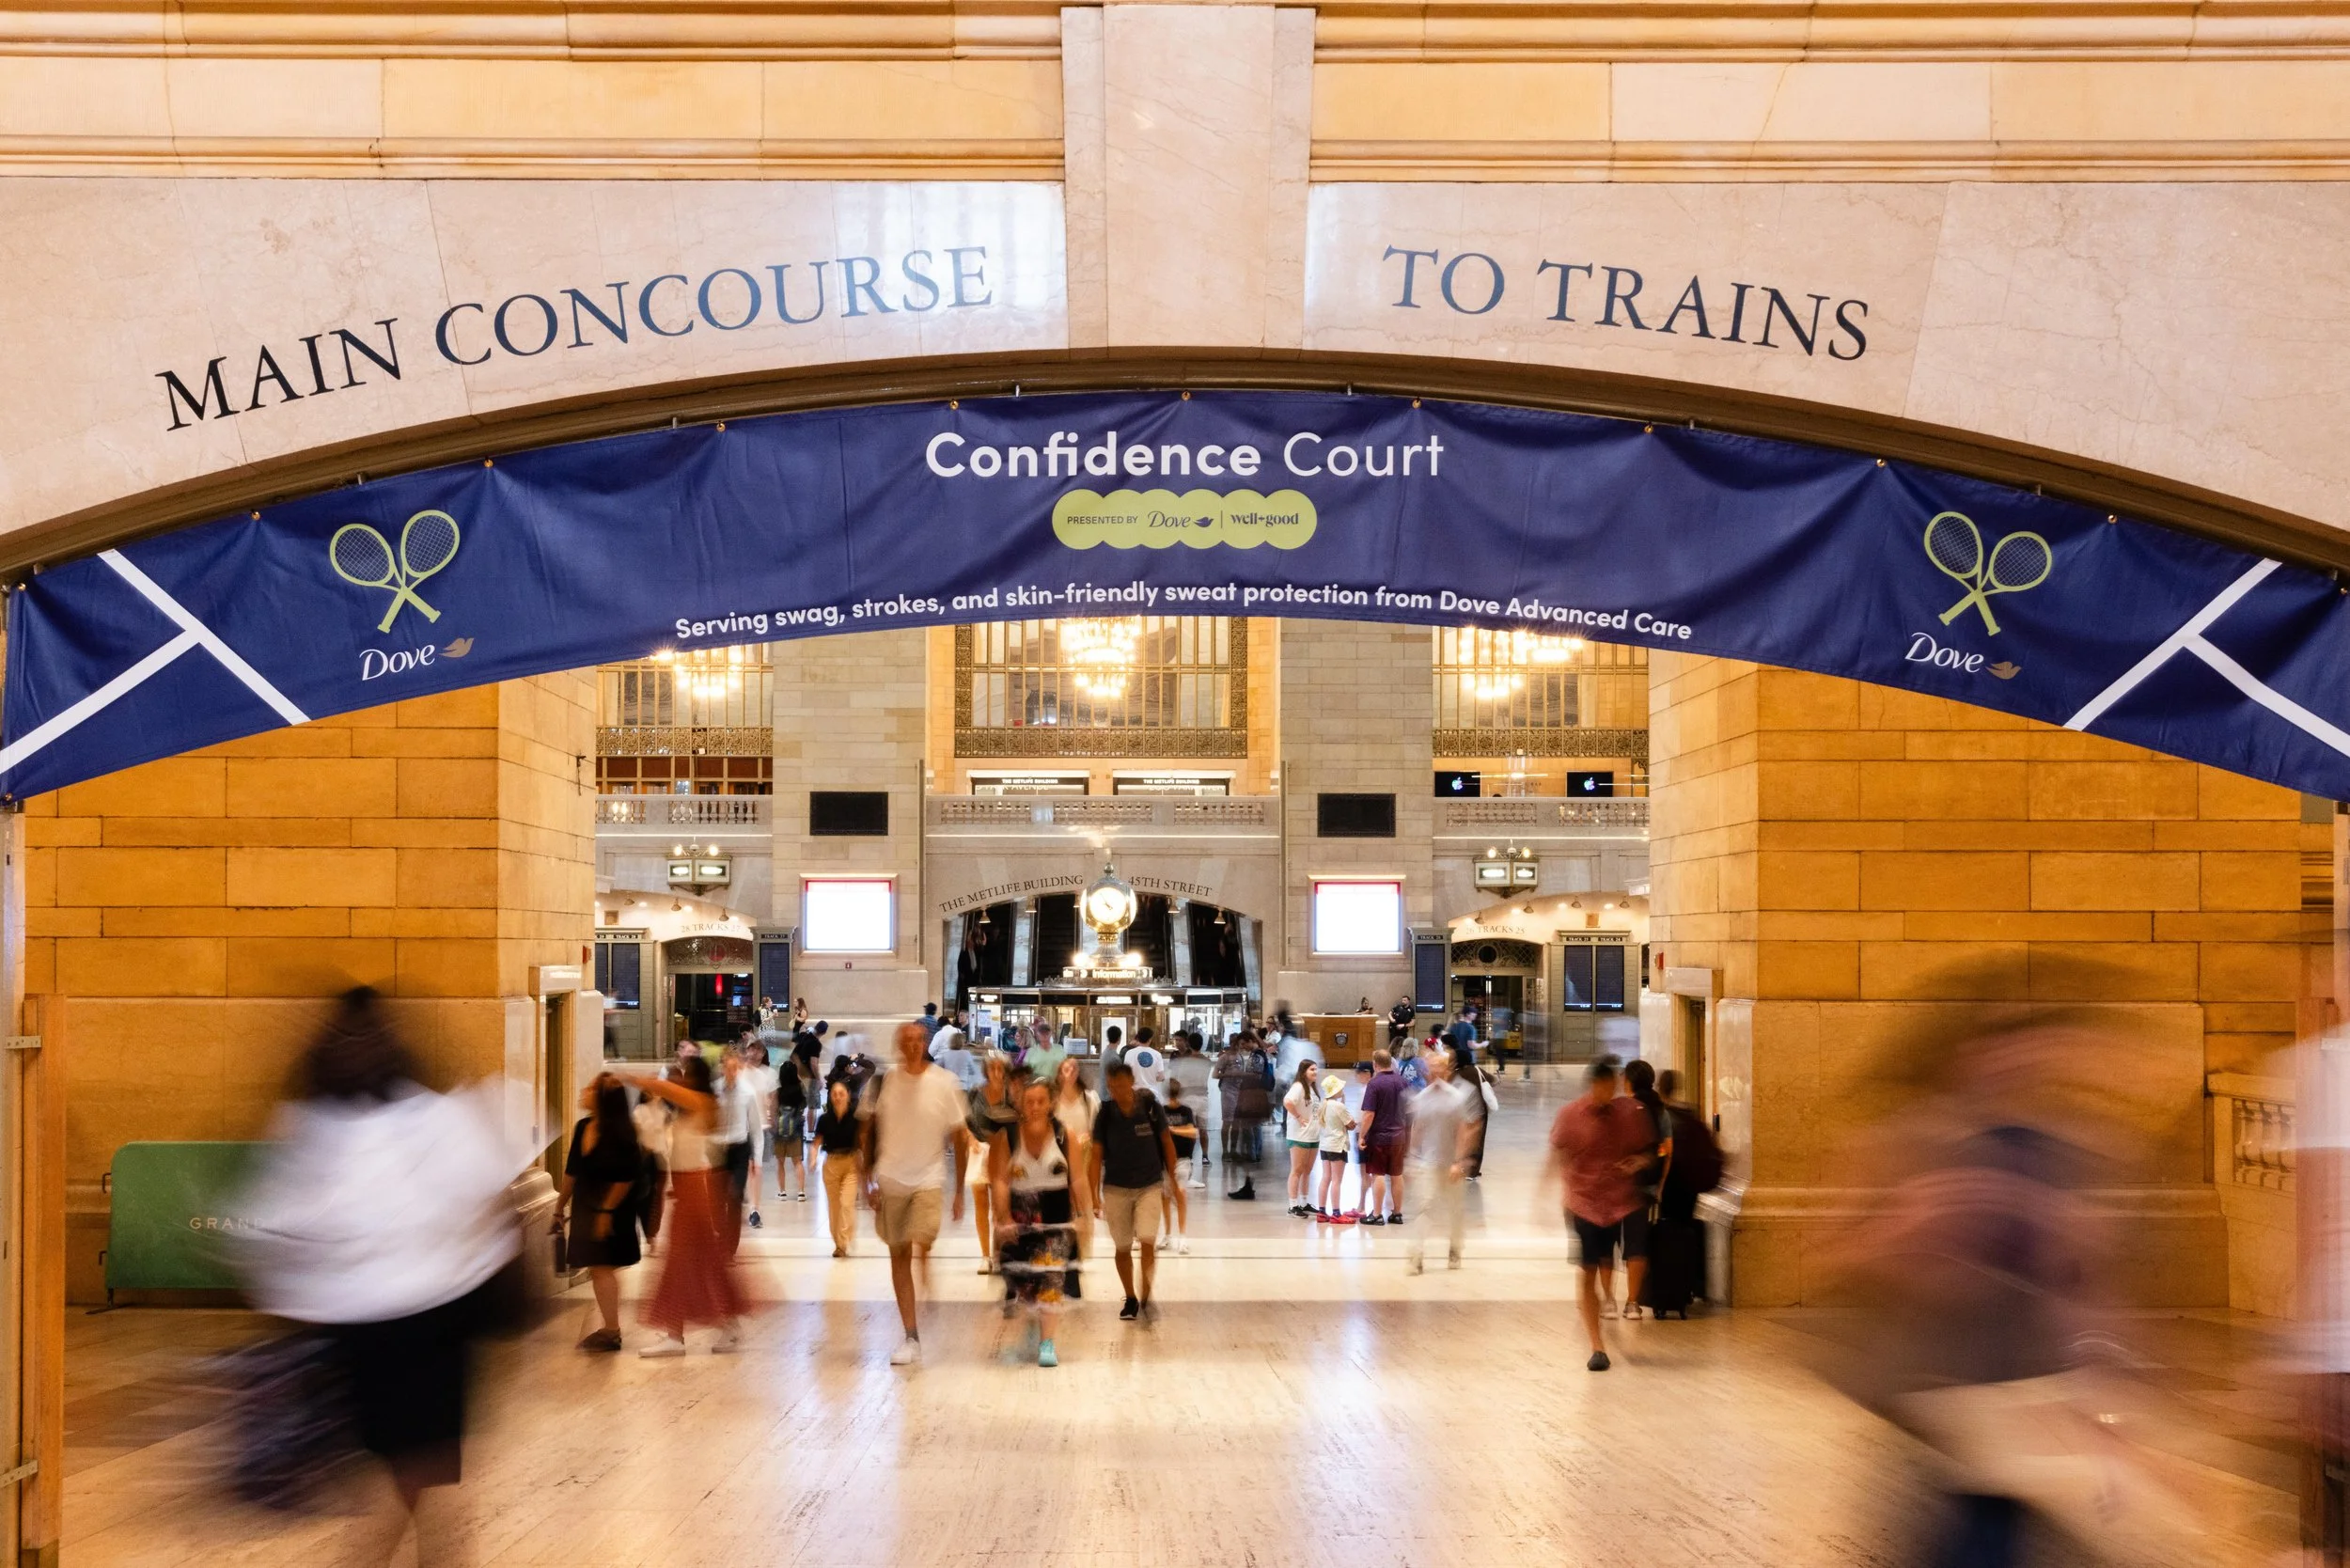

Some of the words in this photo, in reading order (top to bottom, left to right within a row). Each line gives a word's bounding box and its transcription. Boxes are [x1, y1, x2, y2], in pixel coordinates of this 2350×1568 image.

[1383, 244, 1505, 315] TO
[1537, 259, 1869, 361] TRAINS
[155, 318, 401, 431] MAIN
[435, 246, 993, 366] CONCOURSE
[925, 431, 1261, 478] Confidence
[1283, 431, 1445, 478] Court
[1067, 515, 1125, 525] PRESENTED
[1126, 515, 1138, 525] BY
[1147, 510, 1191, 528] Dove
[1230, 512, 1299, 527] well+good
[675, 611, 769, 638] Serving
[776, 604, 846, 627] swag,
[852, 593, 946, 619] strokes,
[951, 588, 999, 610] and
[1005, 580, 1159, 607] skin-friendly
[1165, 583, 1237, 602] sweat
[1244, 584, 1368, 606] protection
[1374, 586, 1433, 609] from
[1439, 590, 1500, 616] Dove
[1505, 597, 1629, 630] Advanced
[1634, 612, 1693, 640] Care
[359, 644, 436, 682] Dove
[1904, 632, 1984, 673] Dove
[939, 897, 964, 913] THE
[966, 882, 1022, 906] METLIFE
[1024, 874, 1084, 891] BUILDING
[1128, 875, 1161, 888] 45TH
[1163, 880, 1213, 898] STREET
[691, 923, 728, 932] TRACKS
[1477, 925, 1513, 933] TRACKS
[1092, 969, 1136, 978] Information
